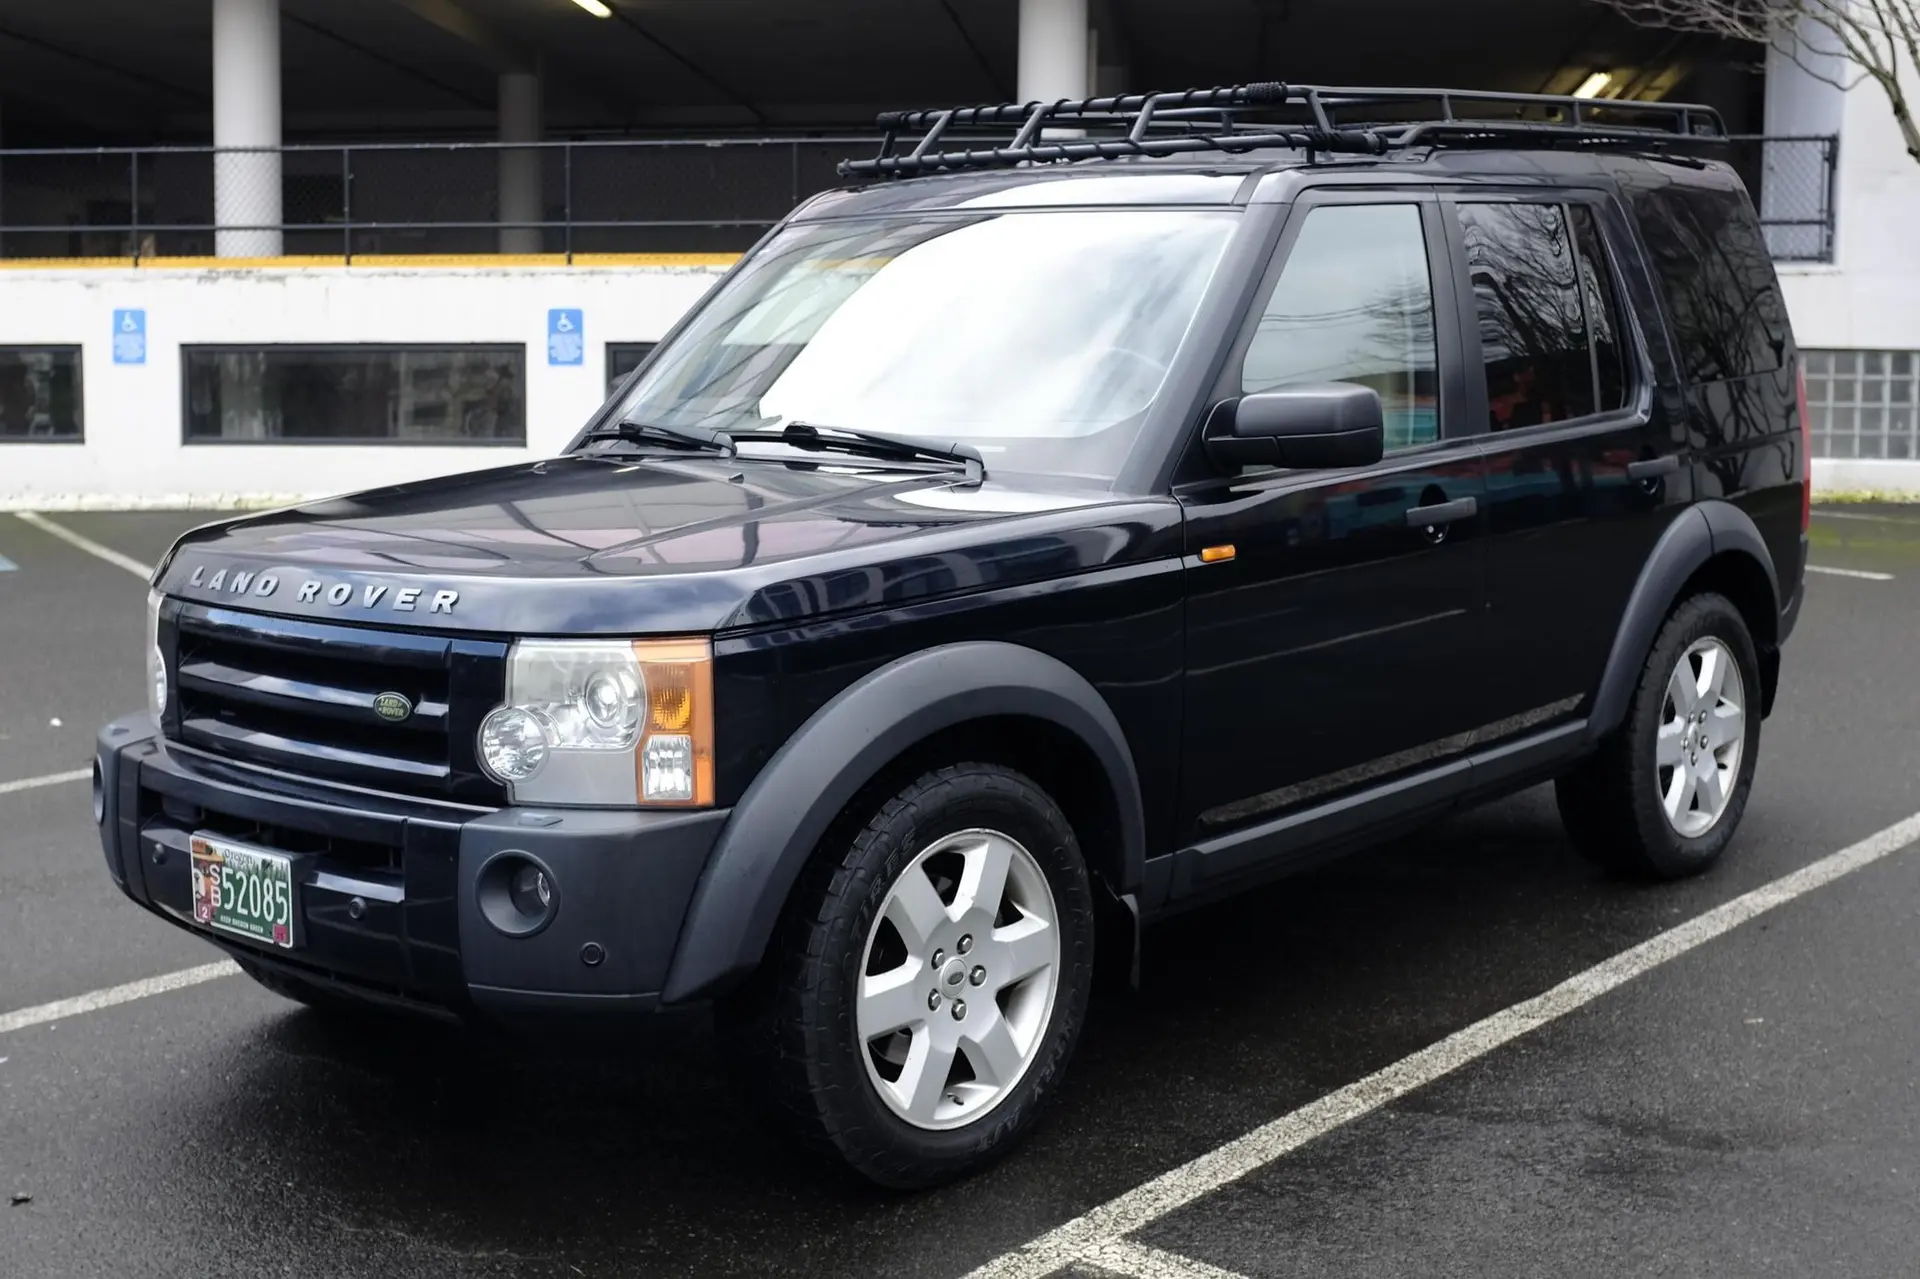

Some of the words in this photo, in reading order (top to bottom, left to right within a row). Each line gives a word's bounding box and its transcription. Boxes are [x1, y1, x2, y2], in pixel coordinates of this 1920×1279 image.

[190, 565, 280, 597] LAND
[296, 580, 460, 614] ROVER
[202, 906, 208, 918] 2
[222, 866, 288, 925] 52085
